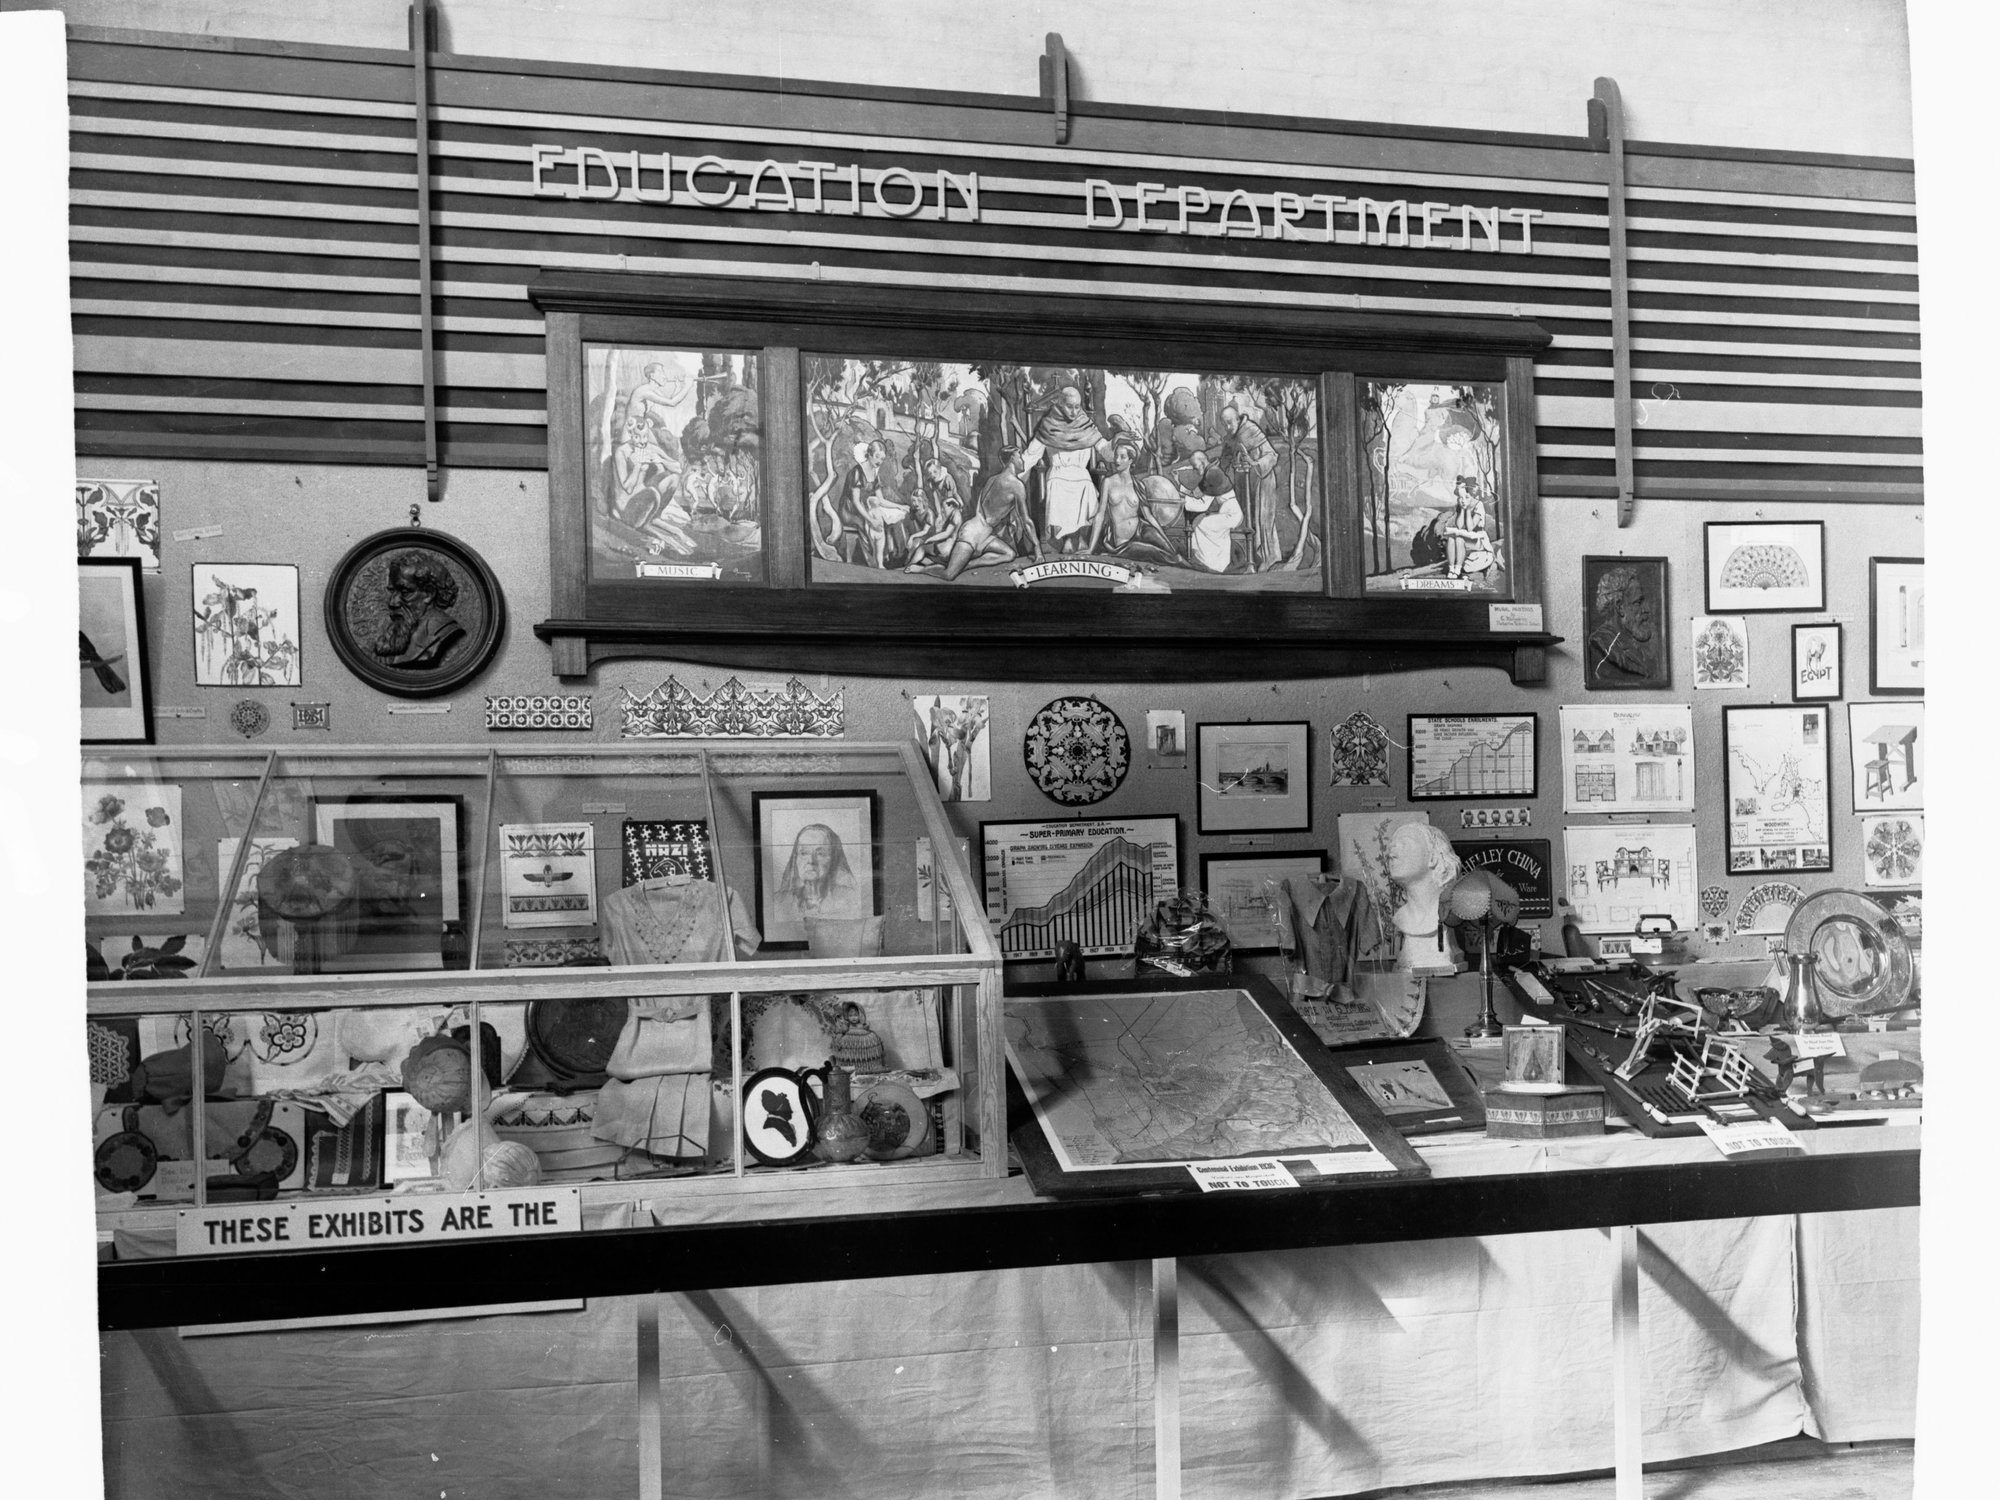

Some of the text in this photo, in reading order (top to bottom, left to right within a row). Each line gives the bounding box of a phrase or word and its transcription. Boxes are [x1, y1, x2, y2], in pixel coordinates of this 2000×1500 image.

[531, 144, 1544, 255] EDUCATION DEPARTMENT
[656, 565, 700, 577] MUSIC
[1035, 562, 1112, 578] LEARNING
[1416, 580, 1455, 589] DREAMS
[1800, 666, 1833, 685] EGYPT
[1029, 829, 1085, 839] SUPER-PRIMARY
[1507, 849, 1542, 880] CHINA
[1519, 882, 1538, 894] Ware
[1725, 1140, 1747, 1150] NOT
[1747, 1138, 1762, 1148] TO
[1196, 1165, 1230, 1174] Centennial
[1228, 1163, 1260, 1173] Exhibition
[1207, 1178, 1290, 1190] NOT TO TOUCH
[204, 1202, 559, 1246] THESE EXHIBITS ARE THE
